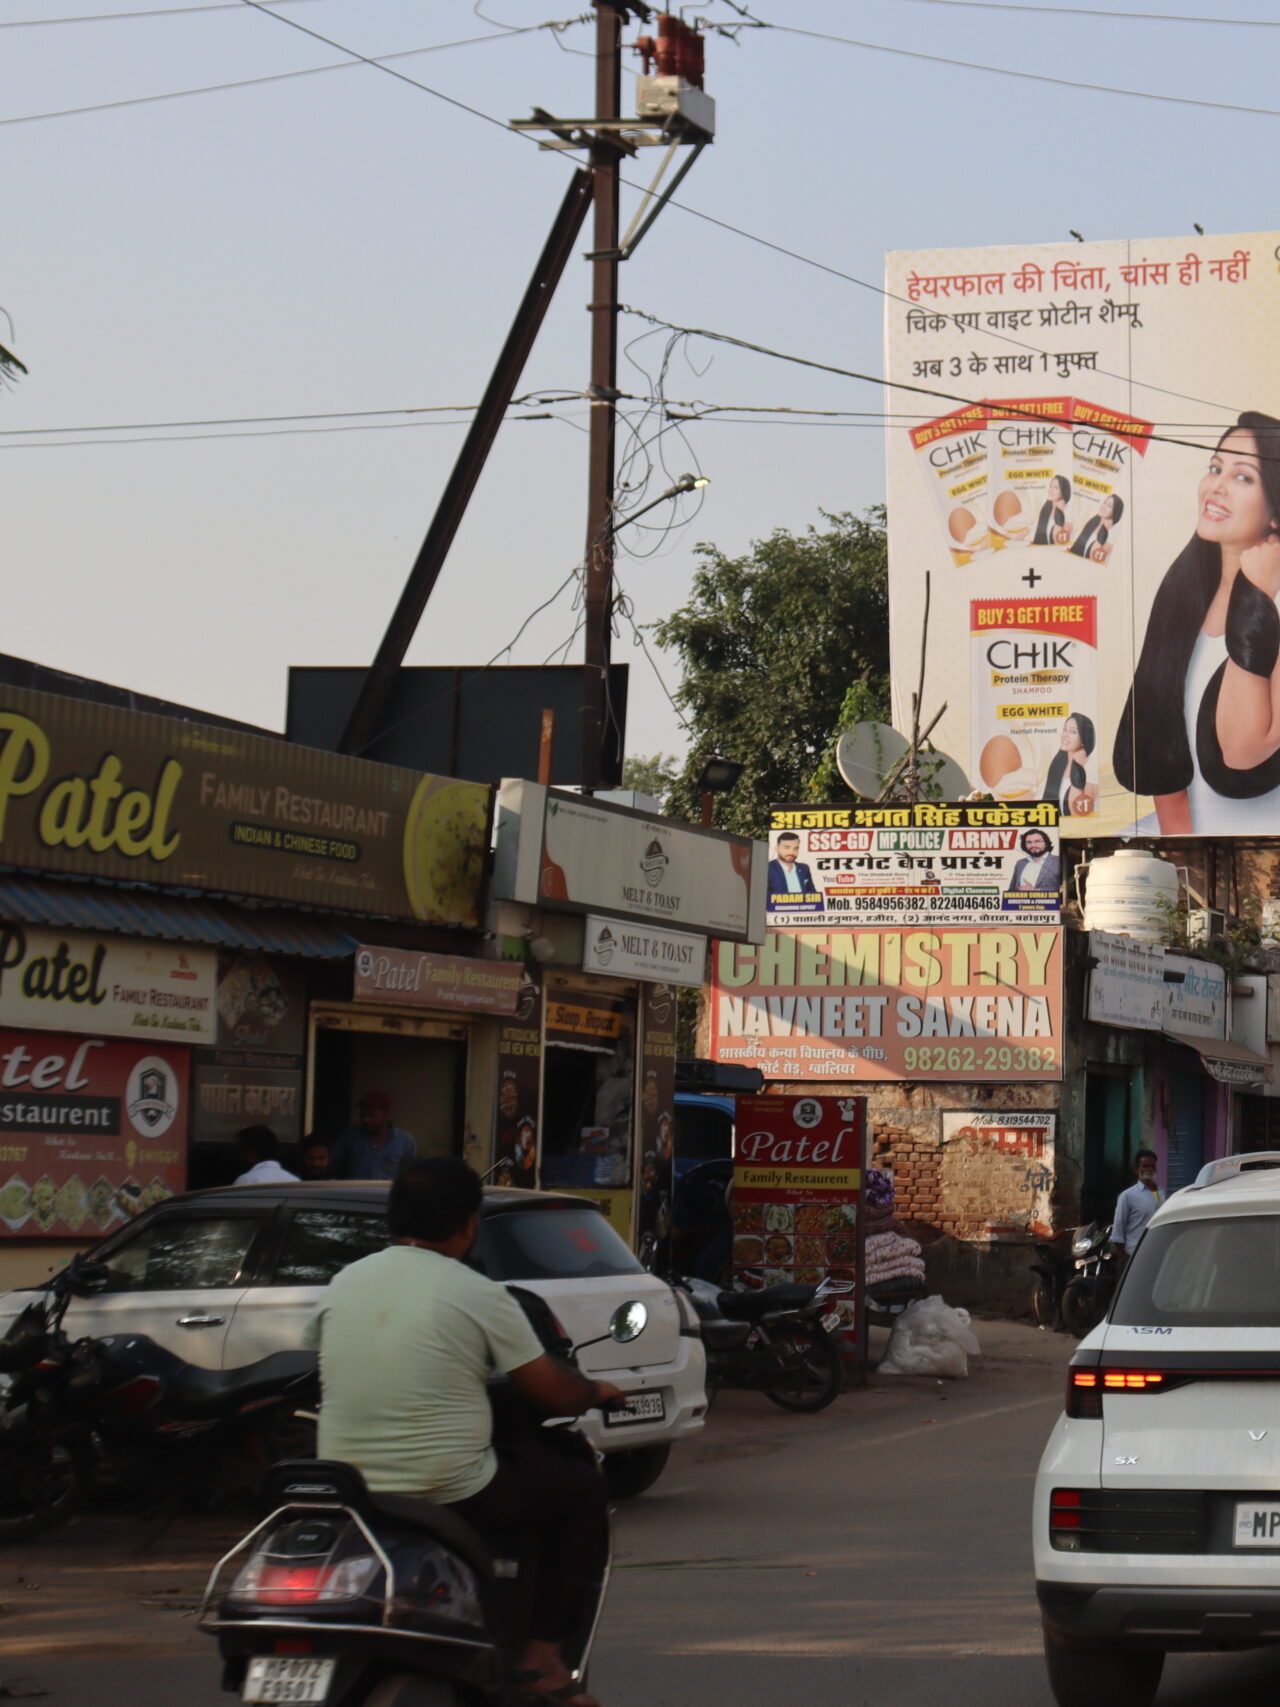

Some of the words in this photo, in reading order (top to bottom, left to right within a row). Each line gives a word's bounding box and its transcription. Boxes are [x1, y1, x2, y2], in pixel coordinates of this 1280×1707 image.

[906, 271, 1006, 301] हेयरफाल
[1012, 263, 1044, 292] की
[1052, 261, 1111, 293] चिंता,
[1120, 258, 1170, 286] चांस
[1177, 253, 1202, 285] ही
[1209, 250, 1251, 283] नहीं
[906, 309, 948, 333] चिक
[950, 312, 981, 333] एग
[987, 310, 1033, 329] वाइट
[1038, 301, 1093, 326] प्रोटीन
[1099, 299, 1143, 328] शैम्पू
[913, 360, 943, 378] अब
[950, 357, 962, 376] 3
[968, 352, 988, 375] के
[994, 355, 1033, 374] साथ
[1039, 352, 1048, 371] 1
[1053, 352, 1098, 378] मुफ्त
[1041, 402, 1063, 415] FREE
[1074, 406, 1091, 419] BUY
[998, 426, 1057, 446] CHIK
[929, 434, 986, 468] CHIK
[1072, 430, 1128, 464] CHIK
[1008, 470, 1025, 479] EGG
[1026, 469, 1050, 479] WHITE
[951, 482, 967, 497] EGG
[1085, 479, 1109, 493] WHITE
[978, 607, 1004, 625] BUY
[1006, 608, 1014, 624] 3
[1017, 606, 1041, 624] GET
[1043, 606, 1050, 623] 1
[1052, 605, 1083, 623] FREE
[986, 640, 1073, 669] CHIK
[994, 674, 1029, 684] Protein
[1031, 673, 1070, 685] Therapy
[1012, 687, 1052, 695] SHAMPOO
[1002, 707, 1025, 717] EGG
[1028, 706, 1063, 717] WHITE
[0, 712, 182, 860] Patel
[771, 810, 851, 829] आजाद
[855, 808, 911, 827] भगत
[914, 804, 963, 827] सिंह
[967, 803, 1058, 826] एकेडमी
[234, 825, 273, 843] INDIAN
[274, 833, 281, 846] &
[284, 833, 327, 854] CHINESE
[329, 841, 356, 859] FOOD
[809, 833, 871, 851] SSC-GD
[879, 832, 900, 849] MP
[901, 831, 942, 850] POLICE
[951, 831, 1014, 849] ARMY
[817, 853, 892, 870] टारगेट
[939, 852, 1004, 870] प्रारंभ
[622, 886, 645, 903] MELT
[646, 892, 652, 906] &
[654, 894, 681, 911] TOAST
[771, 894, 804, 903] PADAM
[805, 893, 821, 902] SIR
[943, 887, 964, 895] Digital
[827, 898, 853, 911] Mob.
[855, 896, 927, 912] 9584956382,
[930, 896, 1000, 911] 8224046463
[774, 915, 790, 924] (1)
[903, 914, 919, 923] (2)
[621, 935, 650, 956] MELT
[652, 938, 658, 958] &
[662, 941, 694, 964] TOAST
[718, 931, 1057, 987] CHEMISTRY
[0, 922, 107, 1006] Patel
[374, 956, 426, 992] Patel
[426, 962, 461, 991] Family
[437, 988, 454, 1001] Pure
[555, 1004, 580, 1027] Sleep
[718, 996, 888, 1037] NAVNEET
[896, 995, 1052, 1038] SAXENA
[719, 1045, 766, 1059] शासकीय
[768, 1047, 797, 1059] कन्या
[848, 1045, 859, 1059] के
[903, 1046, 1056, 1071] 98262-29382
[807, 1062, 856, 1075] ग्वालियर
[971, 1115, 995, 1125] Mob
[740, 1127, 853, 1163] Patel
[744, 1171, 782, 1187] Family
[784, 1172, 848, 1185] Restaurent
[1114, 1456, 1139, 1465] SX
